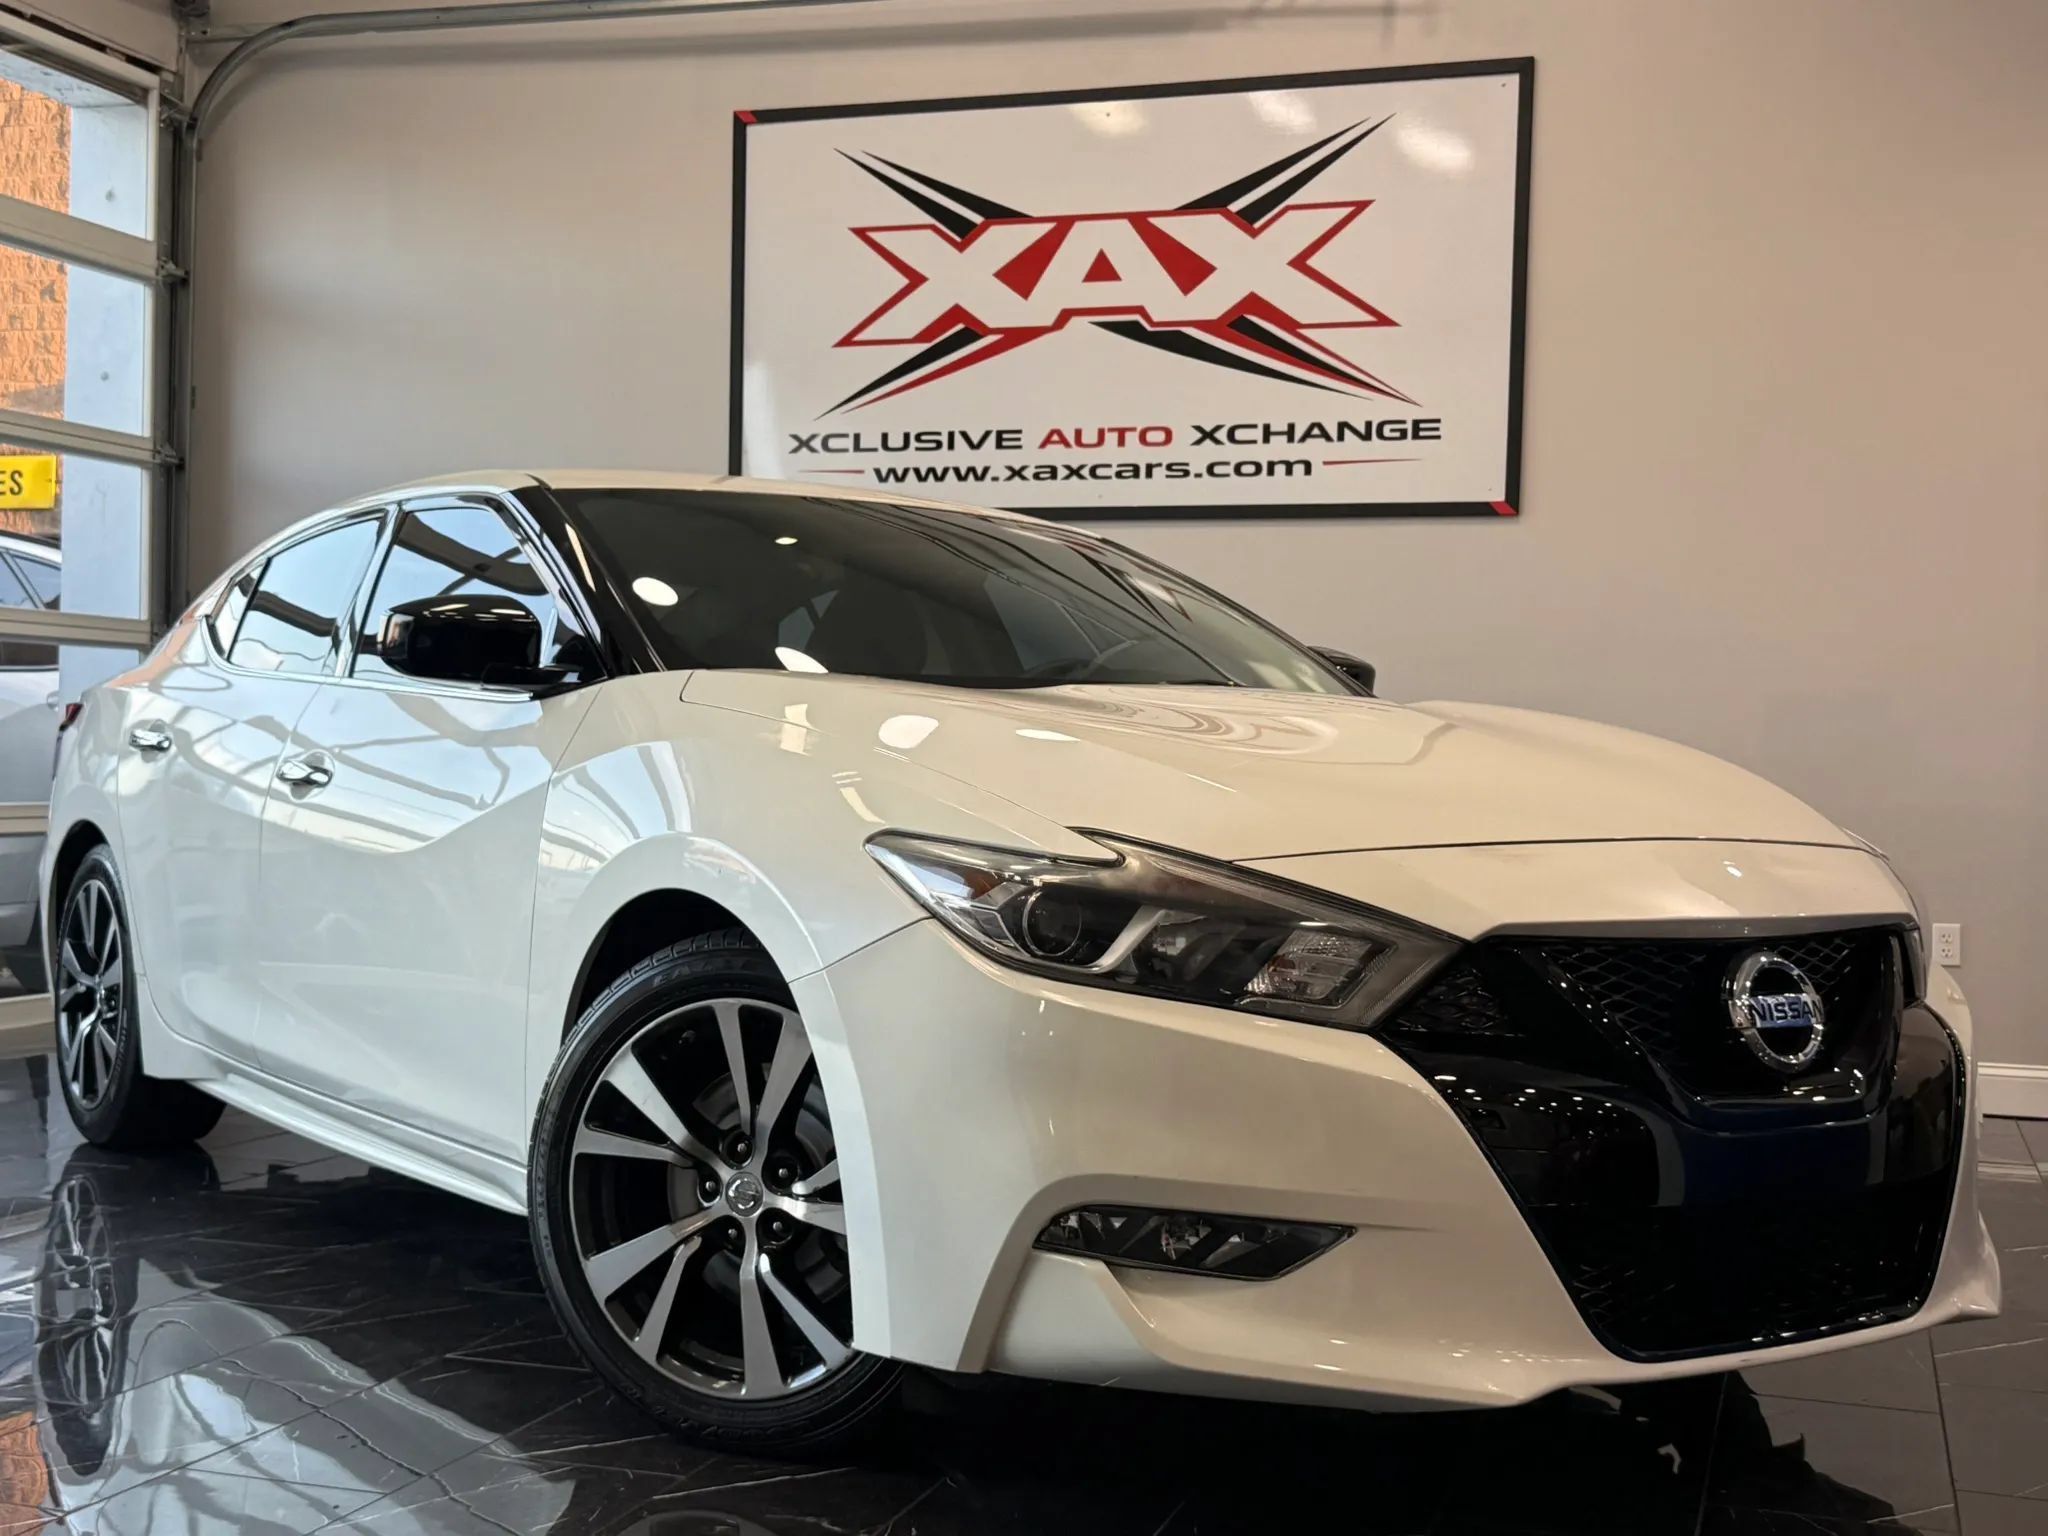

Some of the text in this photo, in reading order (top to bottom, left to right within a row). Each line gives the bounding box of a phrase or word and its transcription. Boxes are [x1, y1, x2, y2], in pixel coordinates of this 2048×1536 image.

[832, 200, 1402, 347] XAX
[788, 418, 1442, 454] XCLUSIVE AUTO XCHANGE
[873, 459, 1312, 483] www.xaxcars.com
[1750, 1000, 1824, 1023] NISSAN
